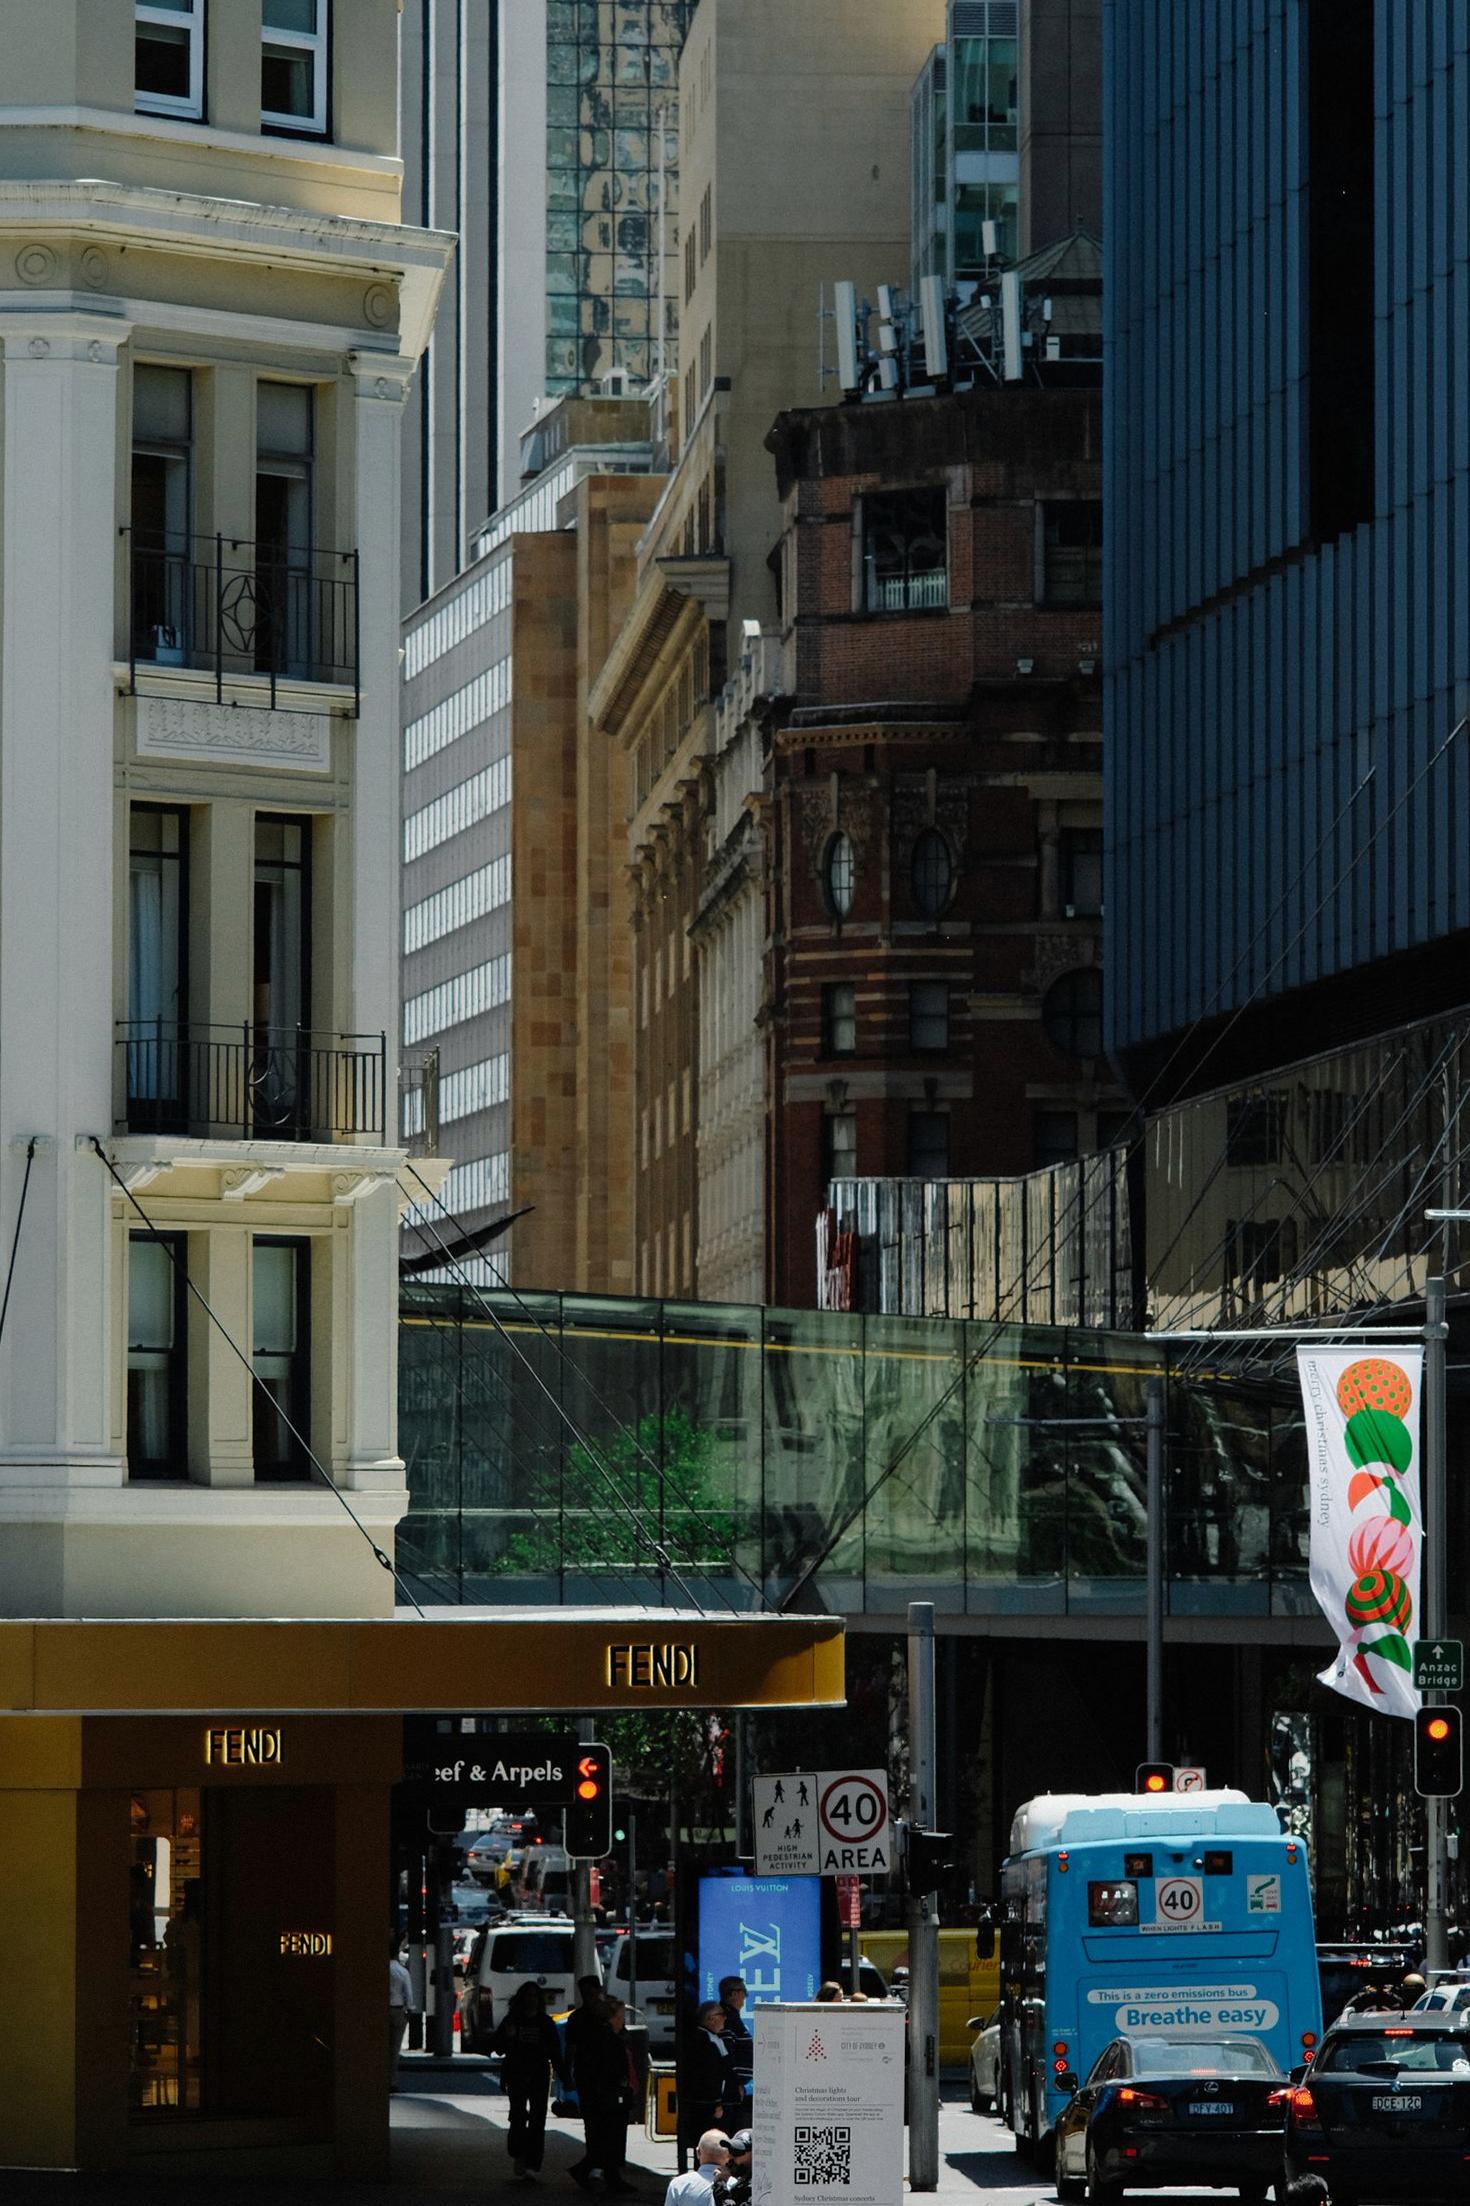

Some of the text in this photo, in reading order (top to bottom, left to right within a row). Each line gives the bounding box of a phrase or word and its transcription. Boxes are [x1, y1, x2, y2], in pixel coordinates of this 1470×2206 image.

[1307, 1360, 1333, 1528] merry christmas sydney
[607, 1645, 699, 1687] FENDI
[1419, 1662, 1457, 1672] Anzac
[1418, 1675, 1458, 1687] Bridge
[206, 1729, 285, 1764] FENDI
[469, 1761, 487, 1781] &
[491, 1760, 563, 1787] Arpels
[829, 1793, 878, 1826] 40
[763, 1852, 813, 1861] PEDESTRIAN
[769, 1861, 807, 1870] ACTIVITY
[824, 1848, 887, 1869] AREA
[731, 1884, 789, 1892] LOUIS VUITTON
[1164, 1890, 1194, 1910] 40
[280, 1932, 333, 1955] FENDI
[1098, 1990, 1120, 2001] This
[1123, 1990, 1132, 2000] is
[1144, 1991, 1169, 2000] zero
[1171, 1989, 1225, 1999] emissions
[1228, 1987, 1248, 1997] bus
[1126, 2006, 1267, 2027] Breathe easy
[794, 2086, 847, 2095] Christmas lights
[793, 2195, 816, 2203] Sydney
[817, 2194, 849, 2202] Christmas
